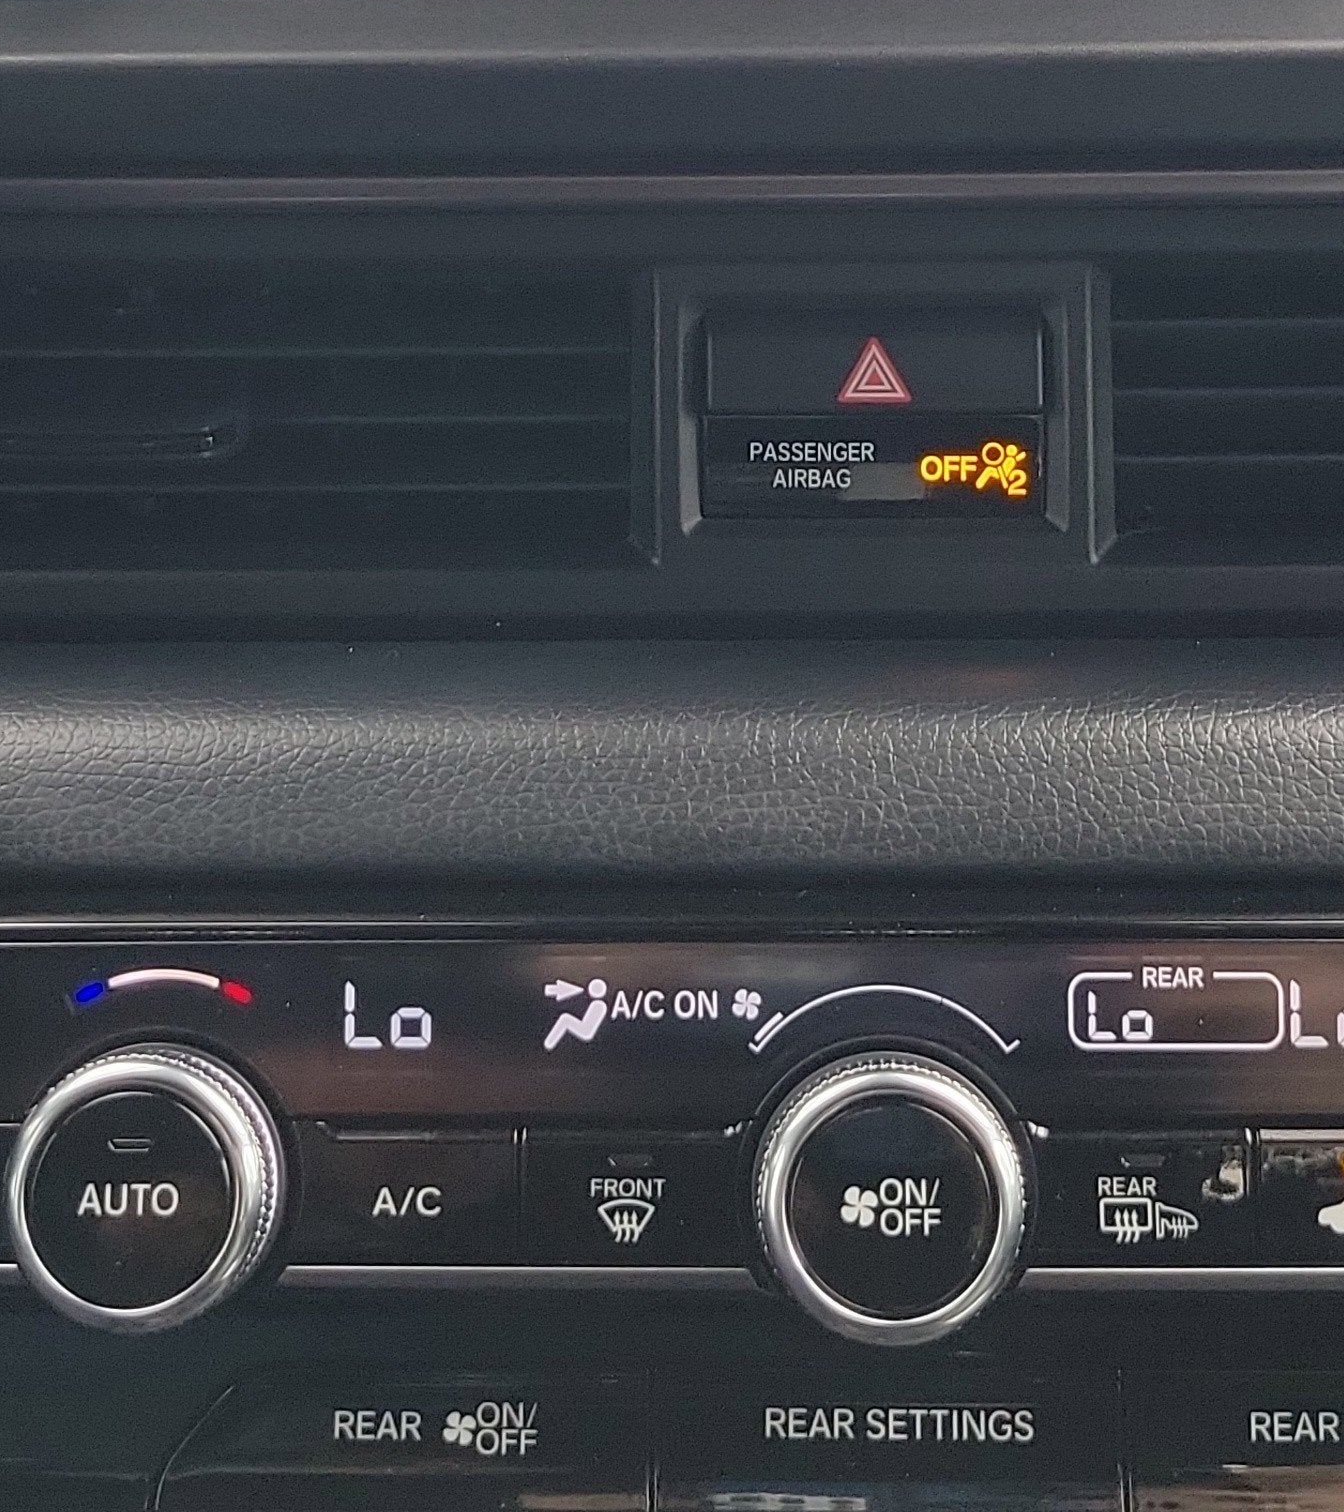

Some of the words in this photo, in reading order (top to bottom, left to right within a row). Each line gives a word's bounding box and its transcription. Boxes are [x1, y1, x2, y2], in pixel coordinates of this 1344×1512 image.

[749, 442, 875, 462] PASSENGER
[769, 465, 853, 491] AIRBAG
[919, 454, 979, 483] OFF
[1142, 966, 1204, 989] REAR
[344, 980, 432, 1049] Lo
[612, 988, 667, 1020] A/C
[674, 989, 718, 1019] ON
[1087, 990, 1154, 1041] Lo
[77, 1182, 179, 1217] AUTO
[590, 1177, 667, 1199] FRONT
[880, 1177, 943, 1207] ON/
[1097, 1176, 1157, 1196] REAR
[372, 1186, 442, 1217] A/C
[880, 1208, 942, 1238] OFF
[333, 1410, 423, 1442] REAR
[476, 1401, 538, 1428] ON/
[765, 1407, 855, 1439] REAR
[866, 1408, 1035, 1441] SETTINGS
[1250, 1410, 1341, 1443] REAR
[476, 1429, 539, 1456] OFF
